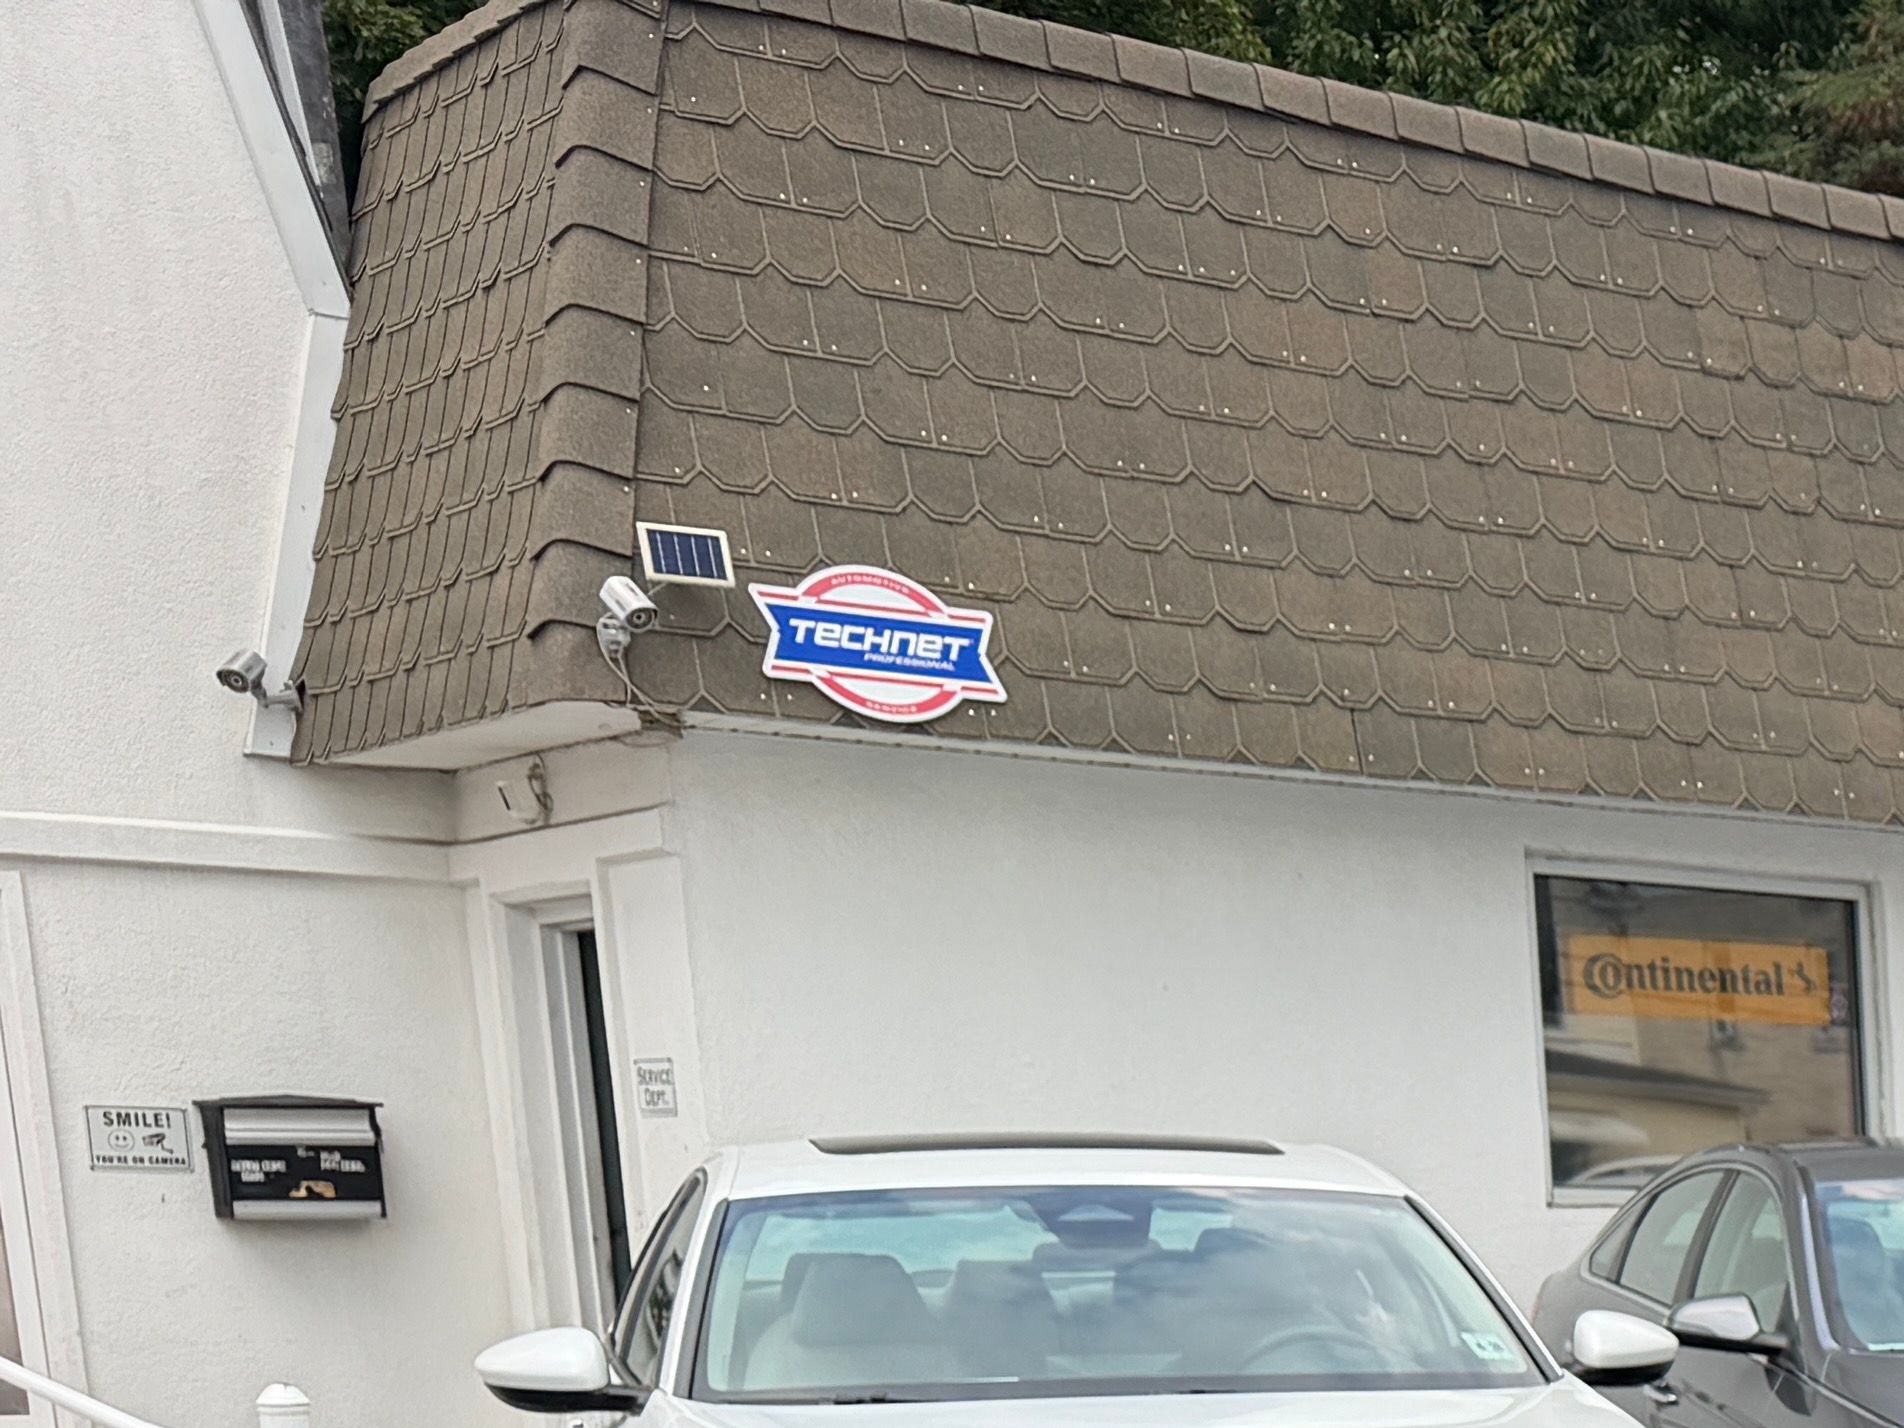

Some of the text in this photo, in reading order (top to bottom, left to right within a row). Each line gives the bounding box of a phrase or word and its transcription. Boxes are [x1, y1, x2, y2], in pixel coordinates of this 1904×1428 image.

[1583, 953, 1785, 998] Continental
[103, 1111, 171, 1129] SMILE!
[132, 1155, 145, 1164] ON
[148, 1155, 186, 1165] CAMERA
